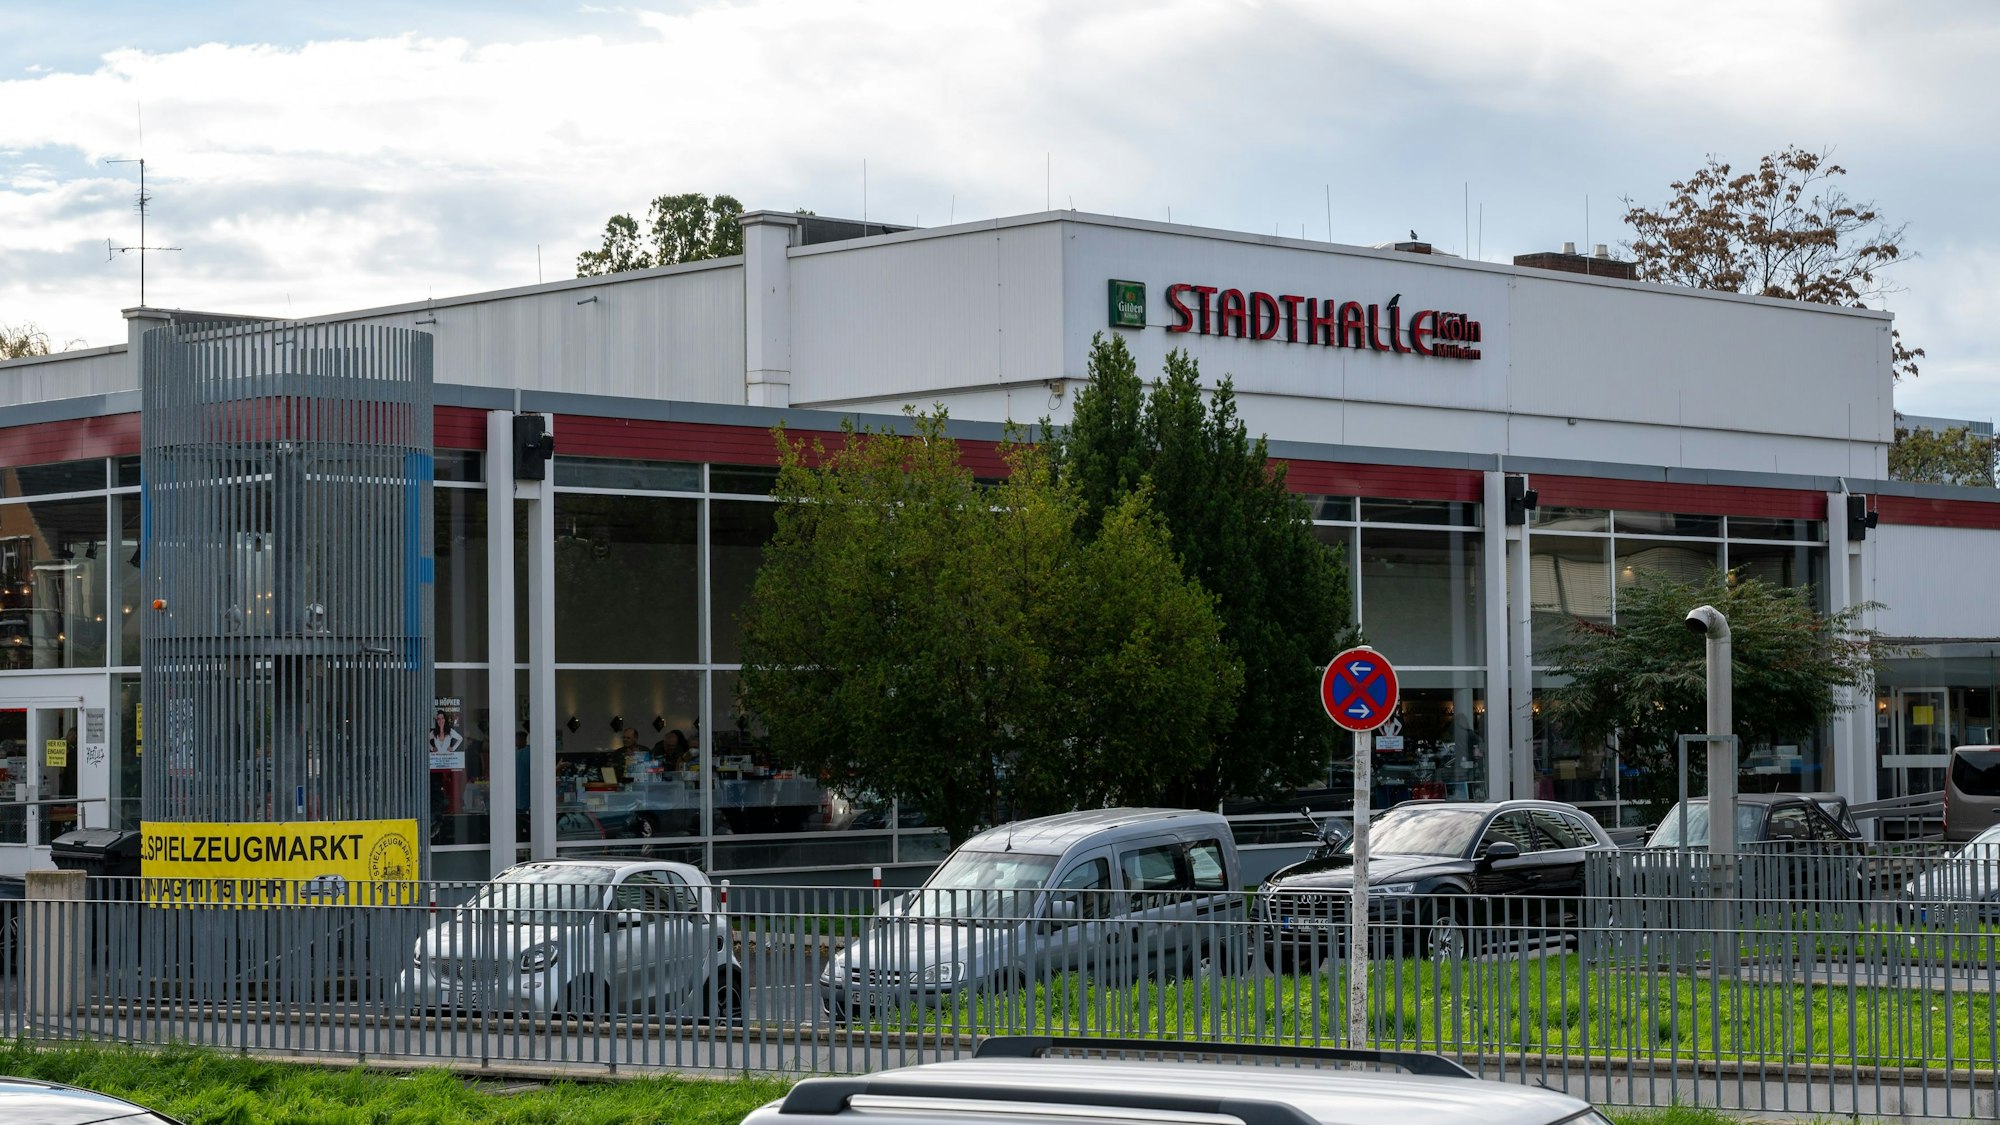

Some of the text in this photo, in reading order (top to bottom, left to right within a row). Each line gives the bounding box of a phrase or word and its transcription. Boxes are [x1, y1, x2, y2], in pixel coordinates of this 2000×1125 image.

[1118, 300, 1143, 313] Gilden
[1165, 283, 1432, 356] STADTHALLE
[1432, 310, 1481, 342] Köln
